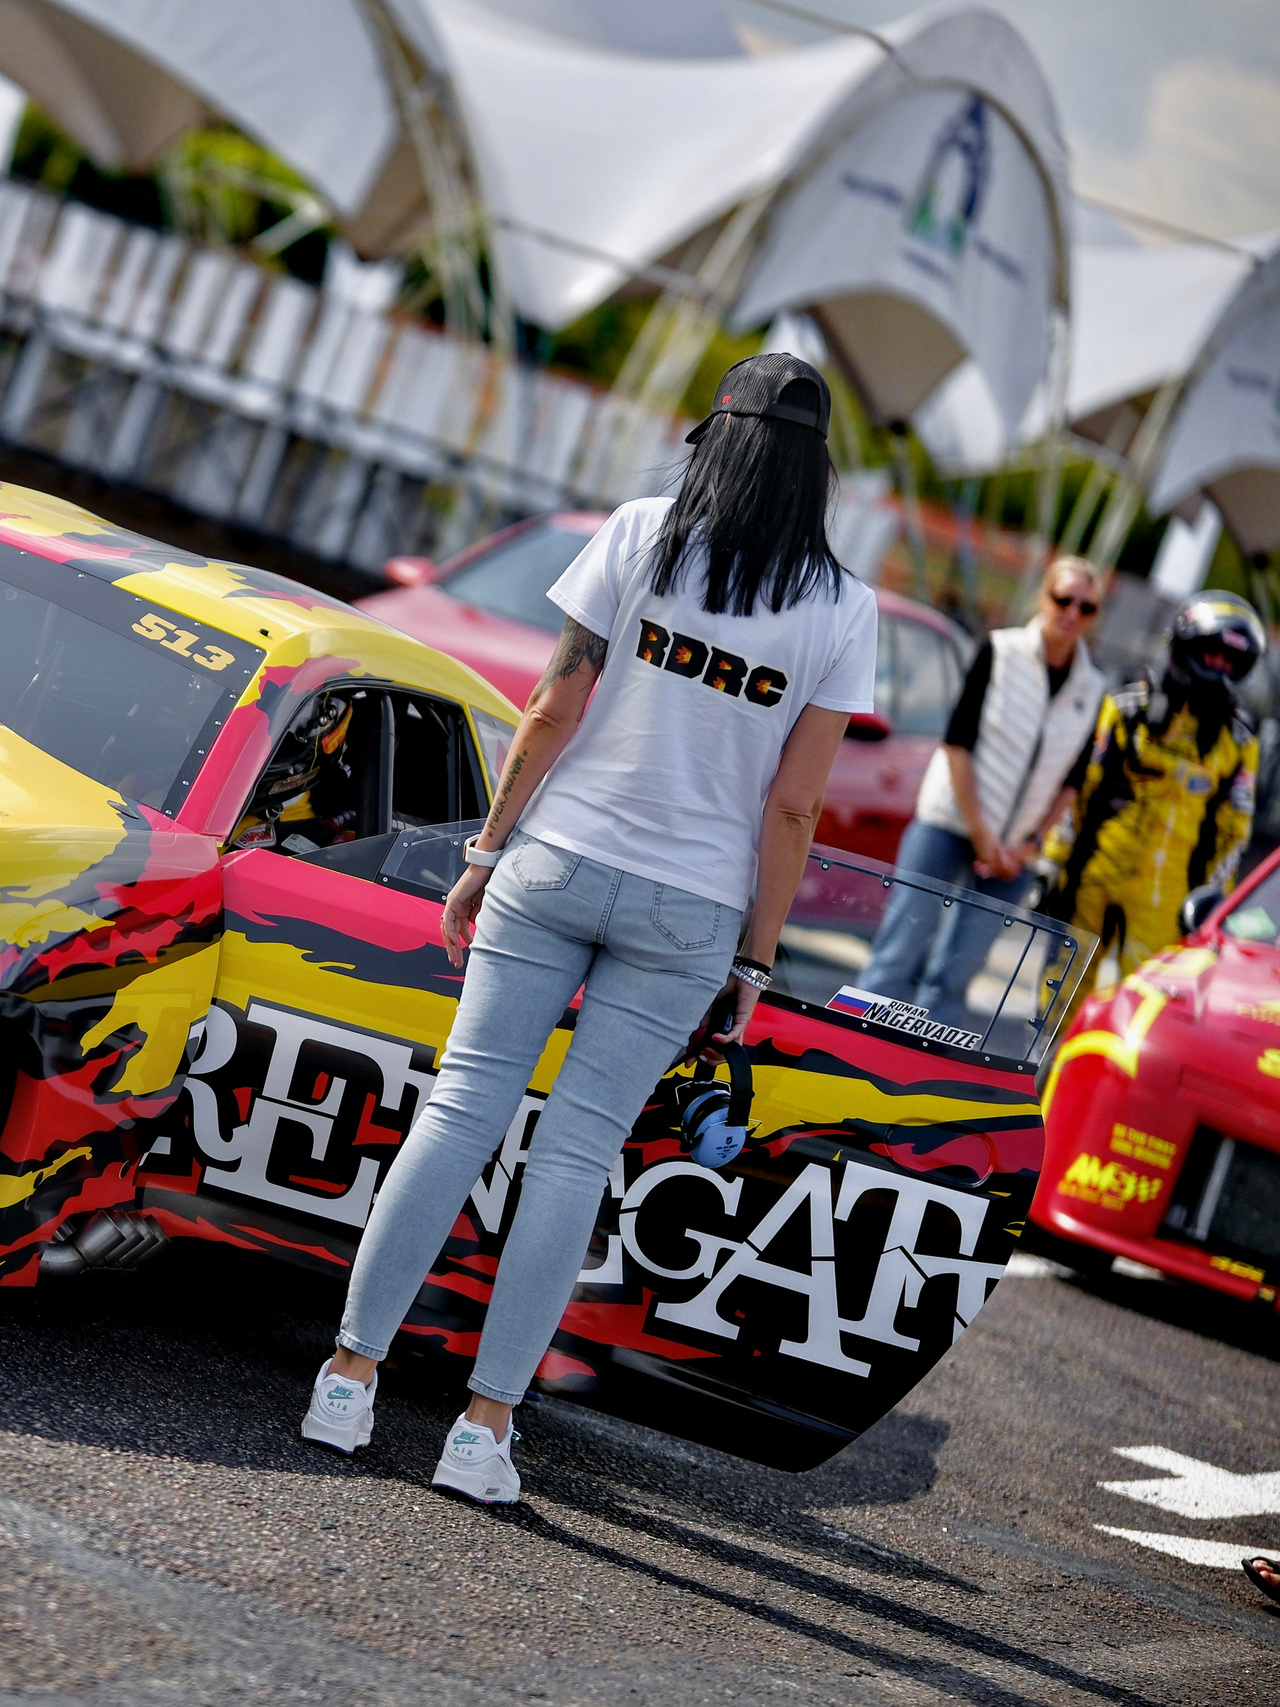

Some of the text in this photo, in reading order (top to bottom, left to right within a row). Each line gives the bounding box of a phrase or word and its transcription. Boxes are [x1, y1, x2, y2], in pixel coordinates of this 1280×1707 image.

[131, 612, 236, 671] 513
[636, 618, 788, 708] RDRC
[888, 1001, 929, 1018] ROMAN
[863, 1003, 981, 1050] NAGERVADZE
[332, 1385, 354, 1398] NIKE
[329, 1401, 348, 1412] AIR
[458, 1431, 480, 1444] NIKE
[454, 1446, 473, 1457] AIR
